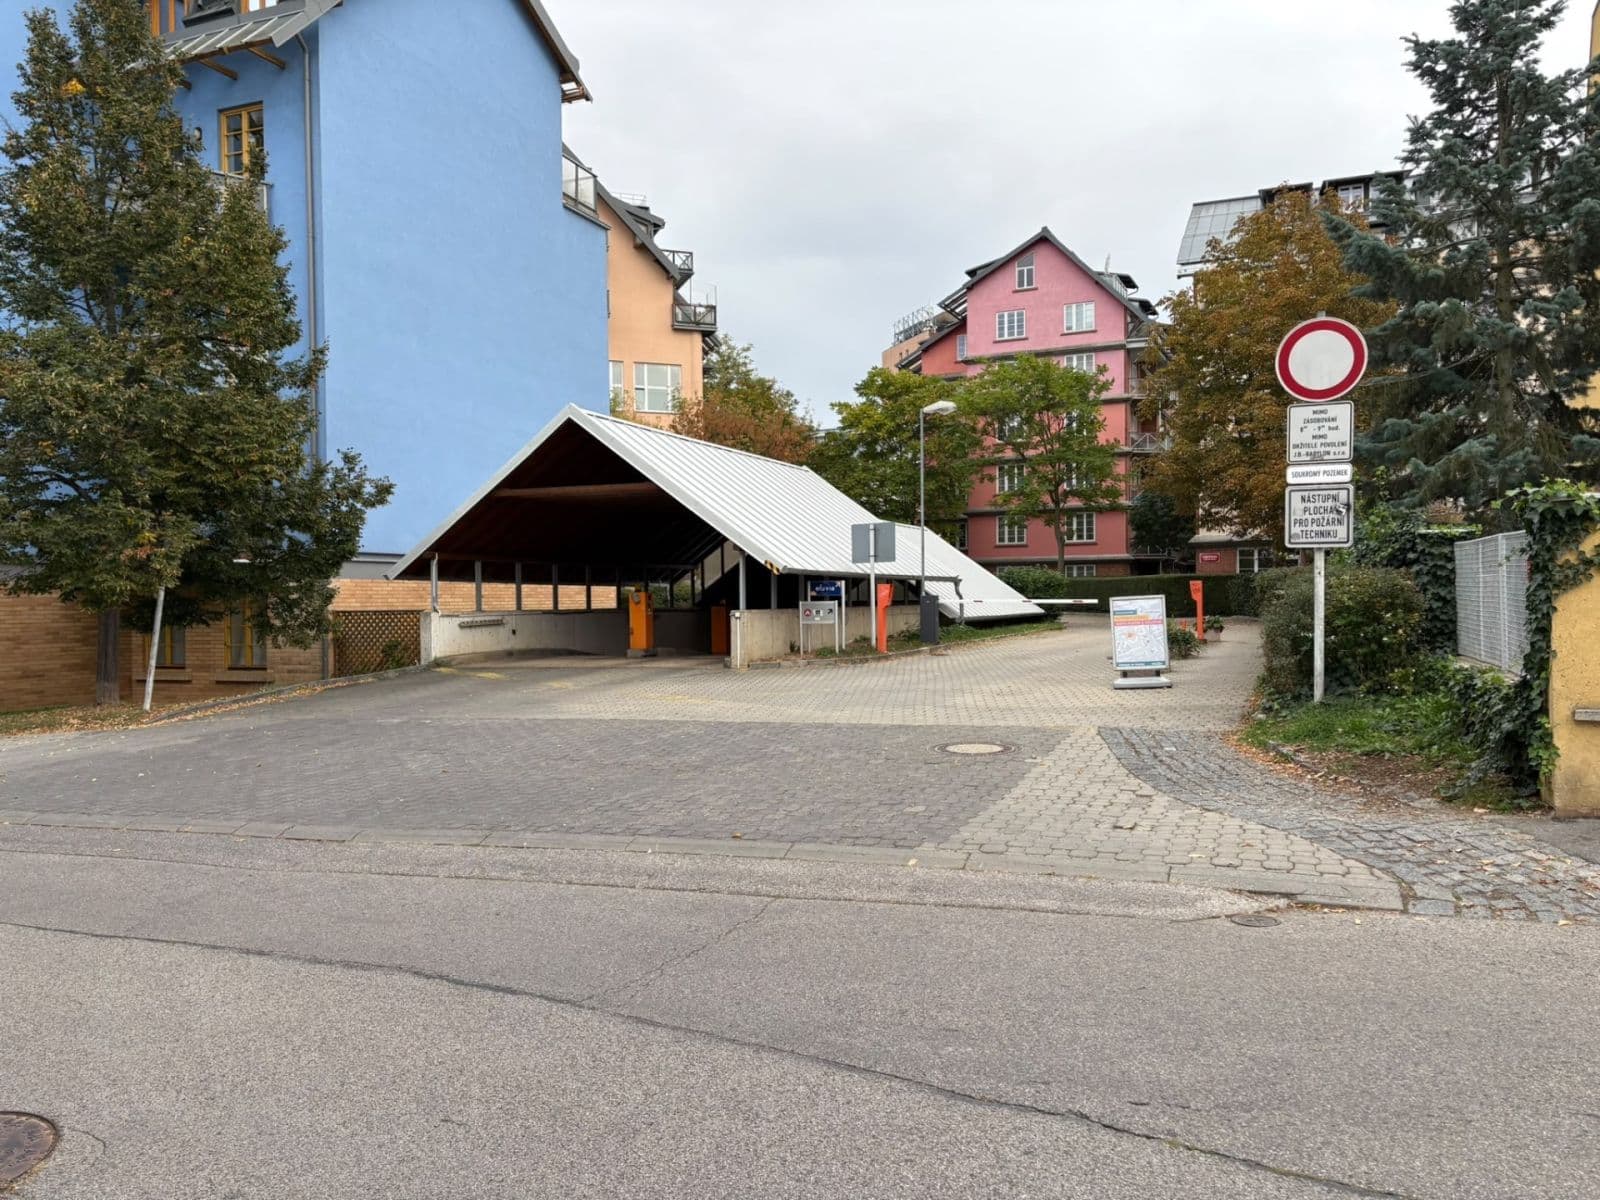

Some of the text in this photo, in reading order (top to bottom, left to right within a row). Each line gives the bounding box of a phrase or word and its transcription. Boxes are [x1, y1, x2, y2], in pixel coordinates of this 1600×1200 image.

[1303, 416, 1337, 424] ZÁSOBOVÁNÍ
[1320, 440, 1347, 448] POVOLENÍ
[1323, 469, 1348, 477] POZEMEK
[1301, 492, 1340, 504] NÁSTUPNÍ
[1303, 505, 1334, 516] PLOCHA
[1293, 515, 1344, 528] PRO POŽÁRNÍ
[1300, 528, 1338, 539] TECHNIKU
